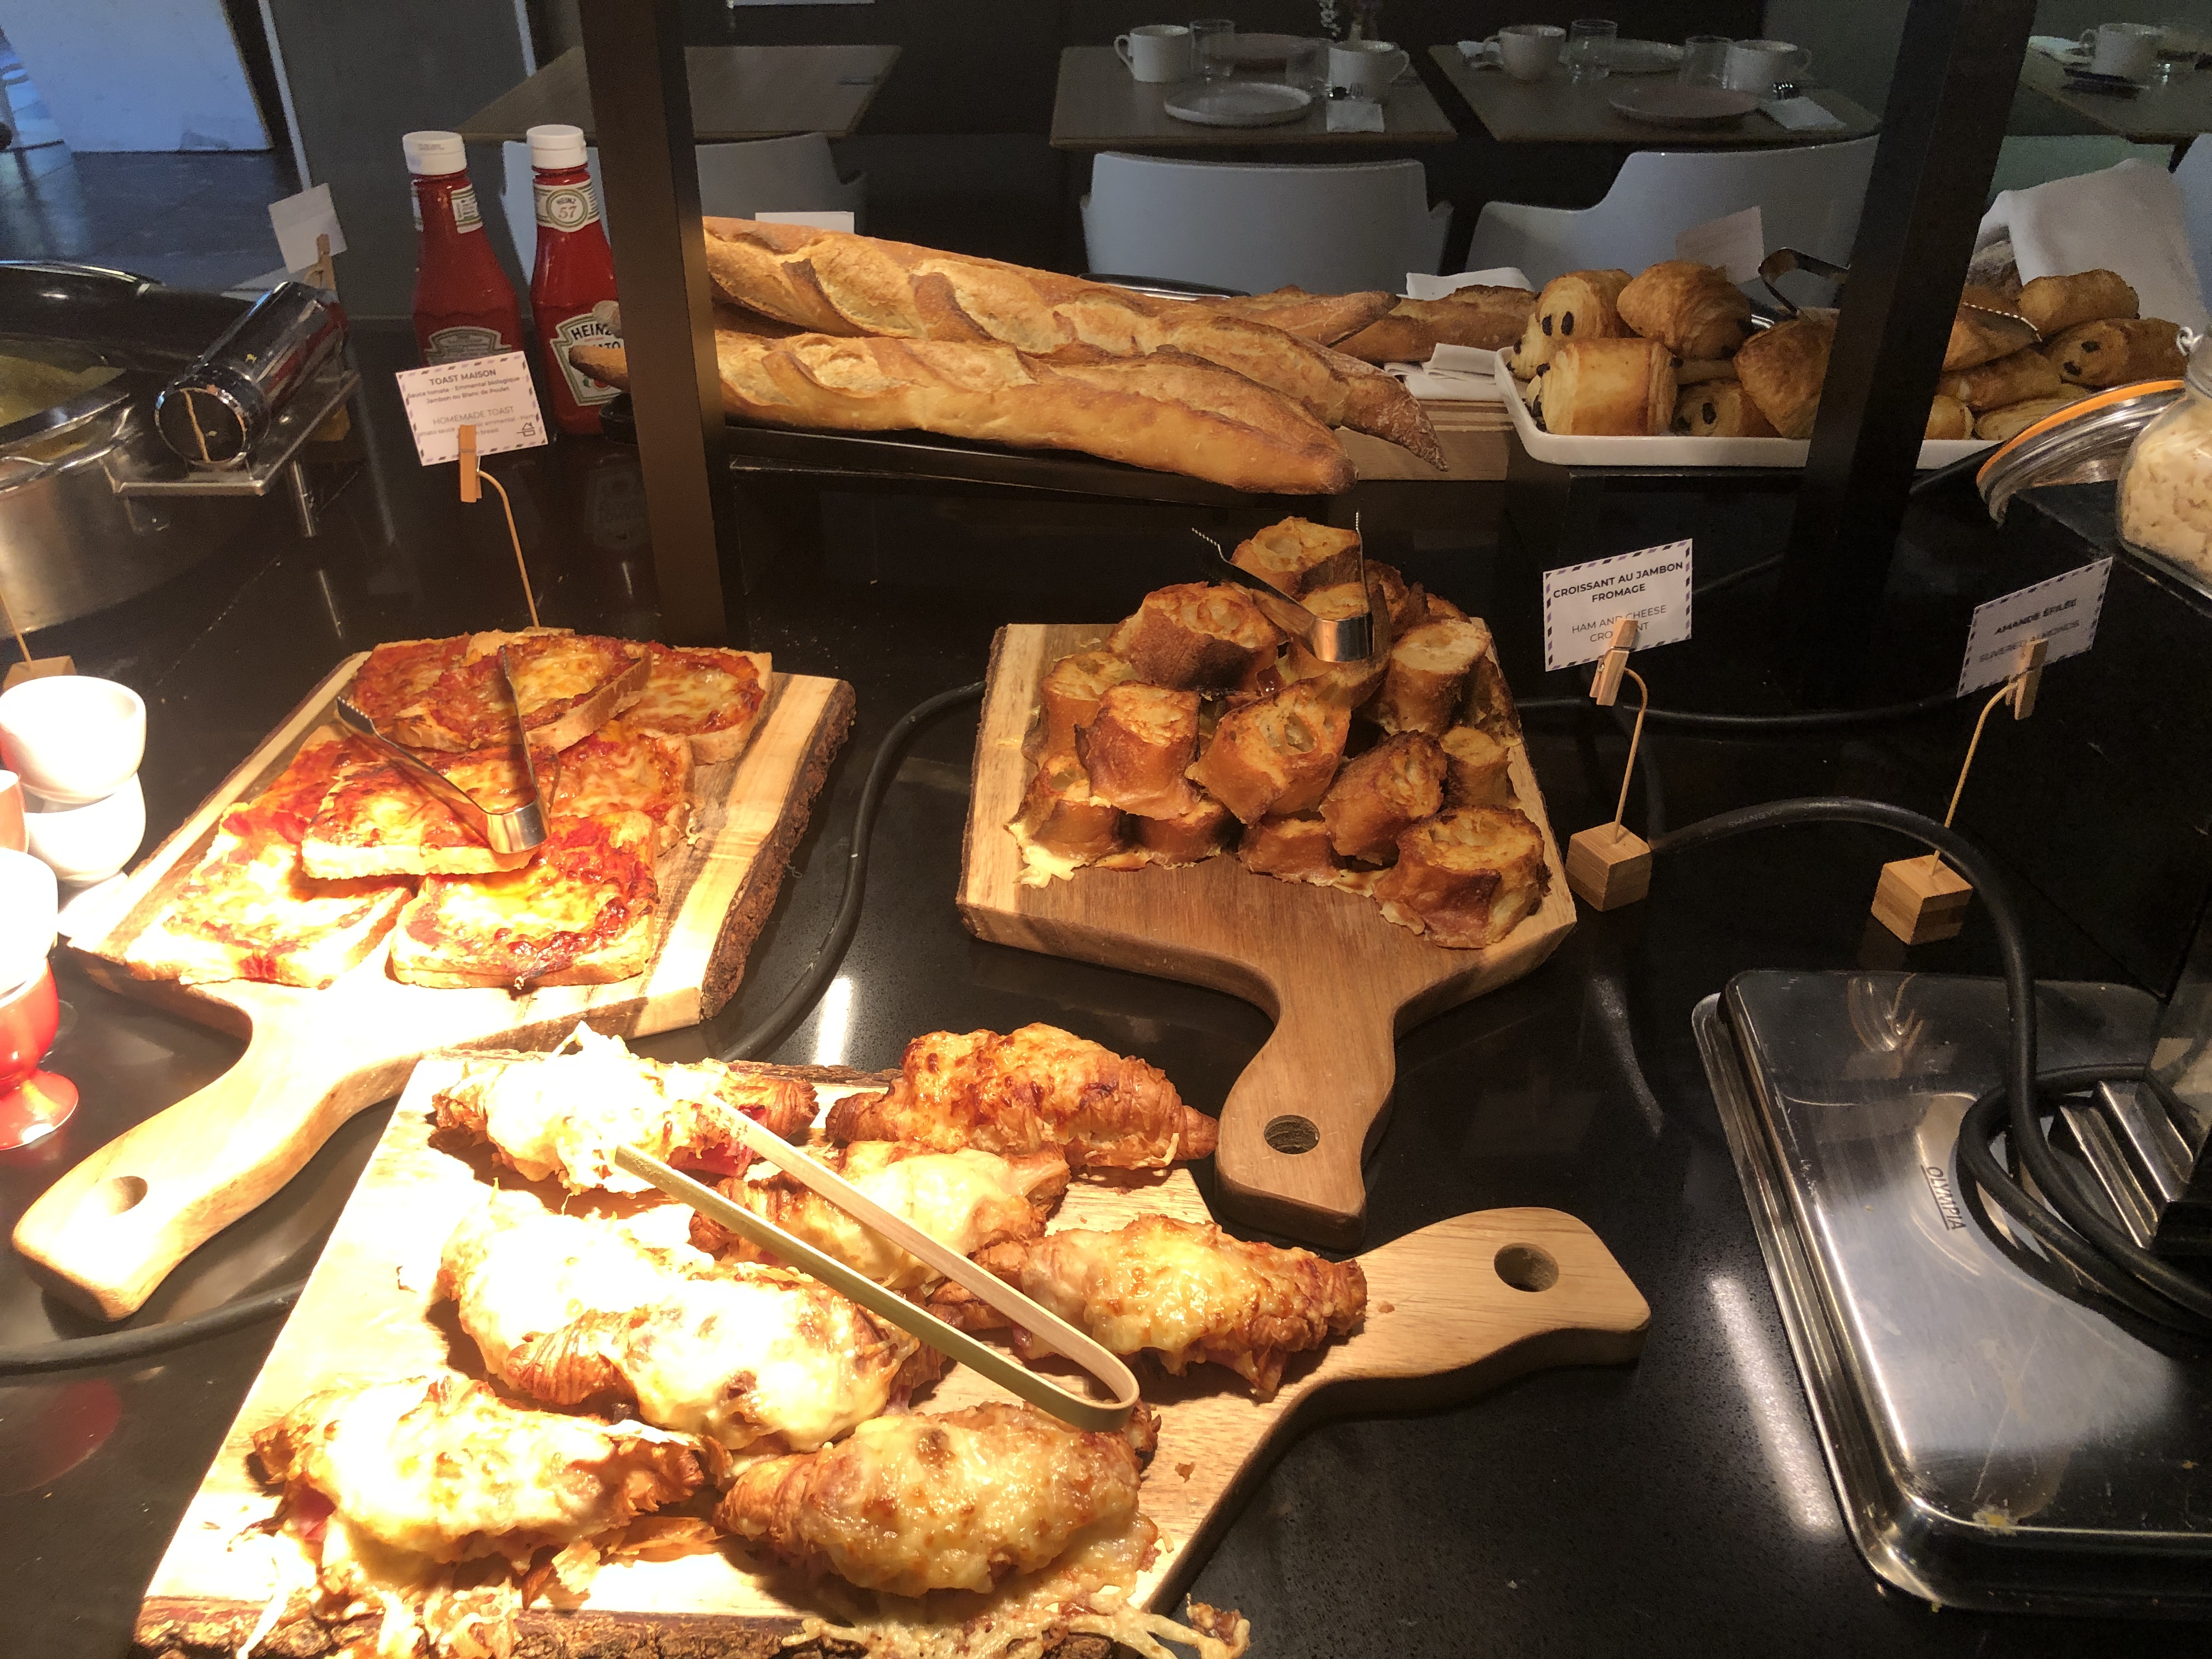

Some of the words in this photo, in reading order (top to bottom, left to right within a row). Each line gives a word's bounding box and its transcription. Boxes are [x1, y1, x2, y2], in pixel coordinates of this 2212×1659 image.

[558, 205, 577, 219] 57
[429, 374, 458, 386] TOAST
[461, 369, 496, 381] MAISON
[488, 376, 520, 386] biologique
[433, 410, 486, 425] HOMEMADE
[487, 406, 514, 416] TOAST
[1553, 577, 1615, 599] CROISSANT
[1618, 573, 1634, 584] AU
[1636, 561, 1684, 579] JAMBON
[1592, 583, 1646, 603] FROMAGE
[1572, 621, 1596, 634] HAM
[1626, 605, 1667, 620] CHEESE
[1590, 622, 1650, 642] CRONT
[1926, 1166, 1967, 1230] OLYMPIA
